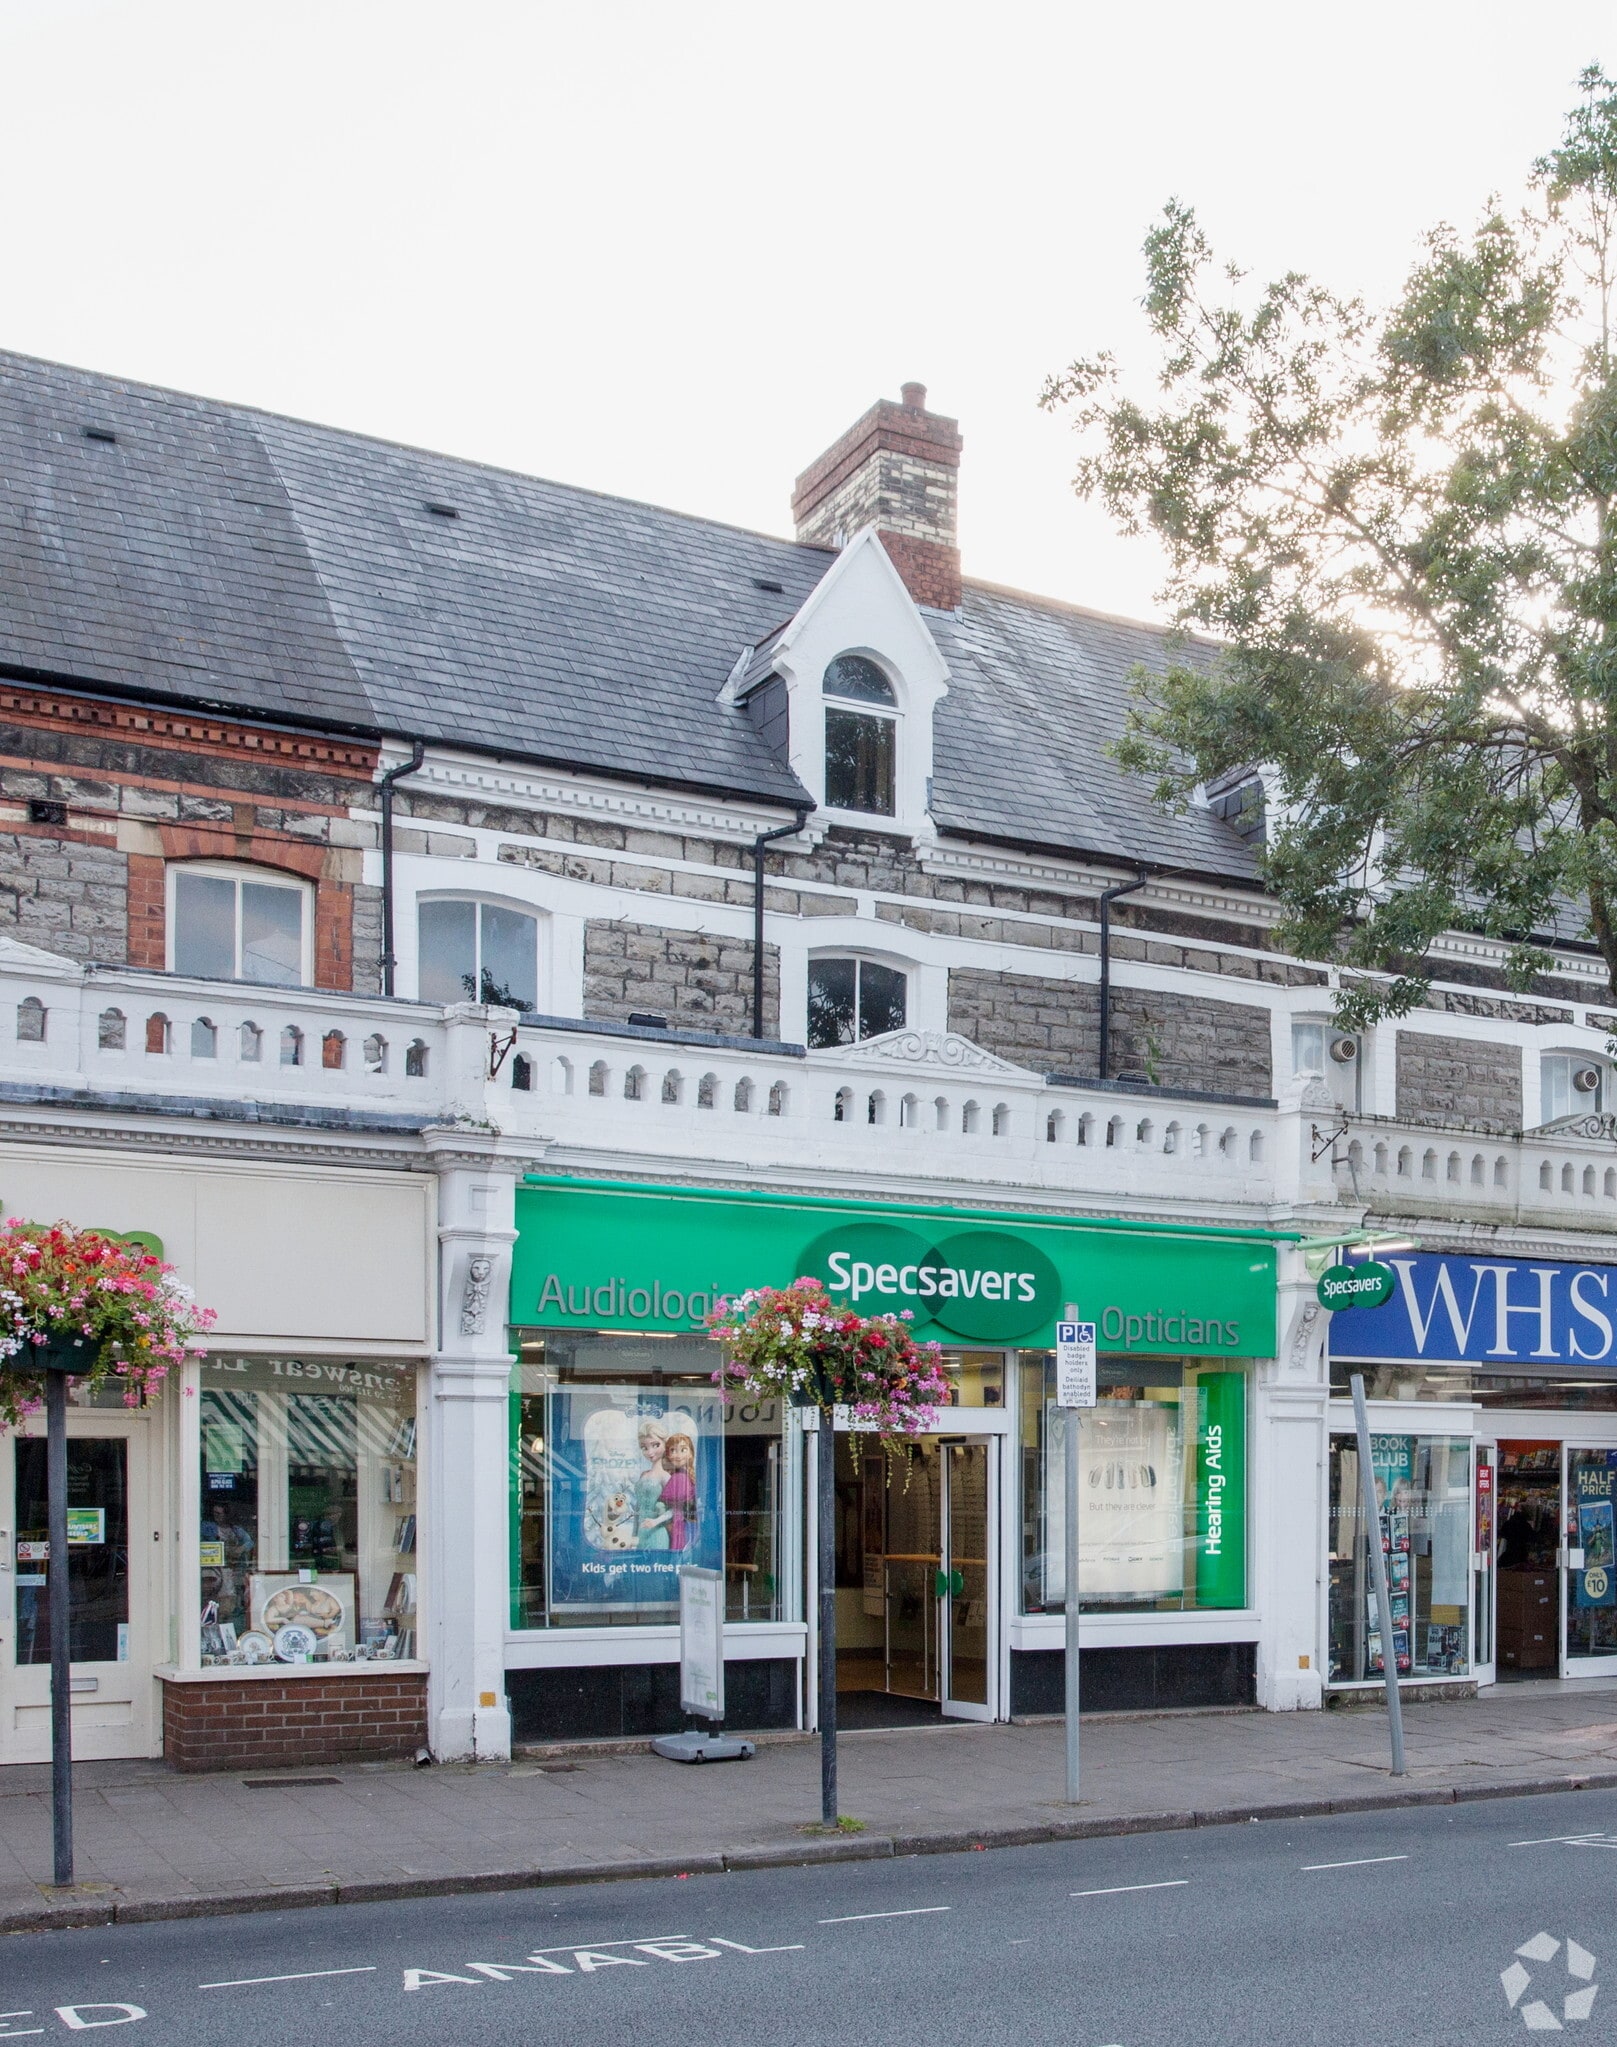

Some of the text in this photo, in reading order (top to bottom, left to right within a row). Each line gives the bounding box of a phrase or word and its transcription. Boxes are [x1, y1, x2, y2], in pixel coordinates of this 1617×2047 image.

[828, 1251, 1036, 1302] Specsavers
[1323, 1277, 1382, 1299] Specsavers
[537, 1273, 768, 1331] Audiologis
[1389, 1259, 1614, 1361] WHS
[1062, 1326, 1074, 1342] P
[1101, 1305, 1240, 1349] Opticians
[1067, 1352, 1086, 1360] badge
[1371, 1437, 1408, 1451] BOOK
[1372, 1452, 1408, 1467] CLUB
[1578, 1471, 1616, 1485] HALF
[1205, 1424, 1226, 1555] Hearing Aids
[1582, 1485, 1612, 1496] PRICE
[1089, 1502, 1156, 1512] But they are clever
[582, 1562, 606, 1573] Kids
[608, 1563, 628, 1575] get
[630, 1563, 651, 1573] two
[653, 1562, 674, 1573] free
[1587, 1580, 1605, 1593] £10
